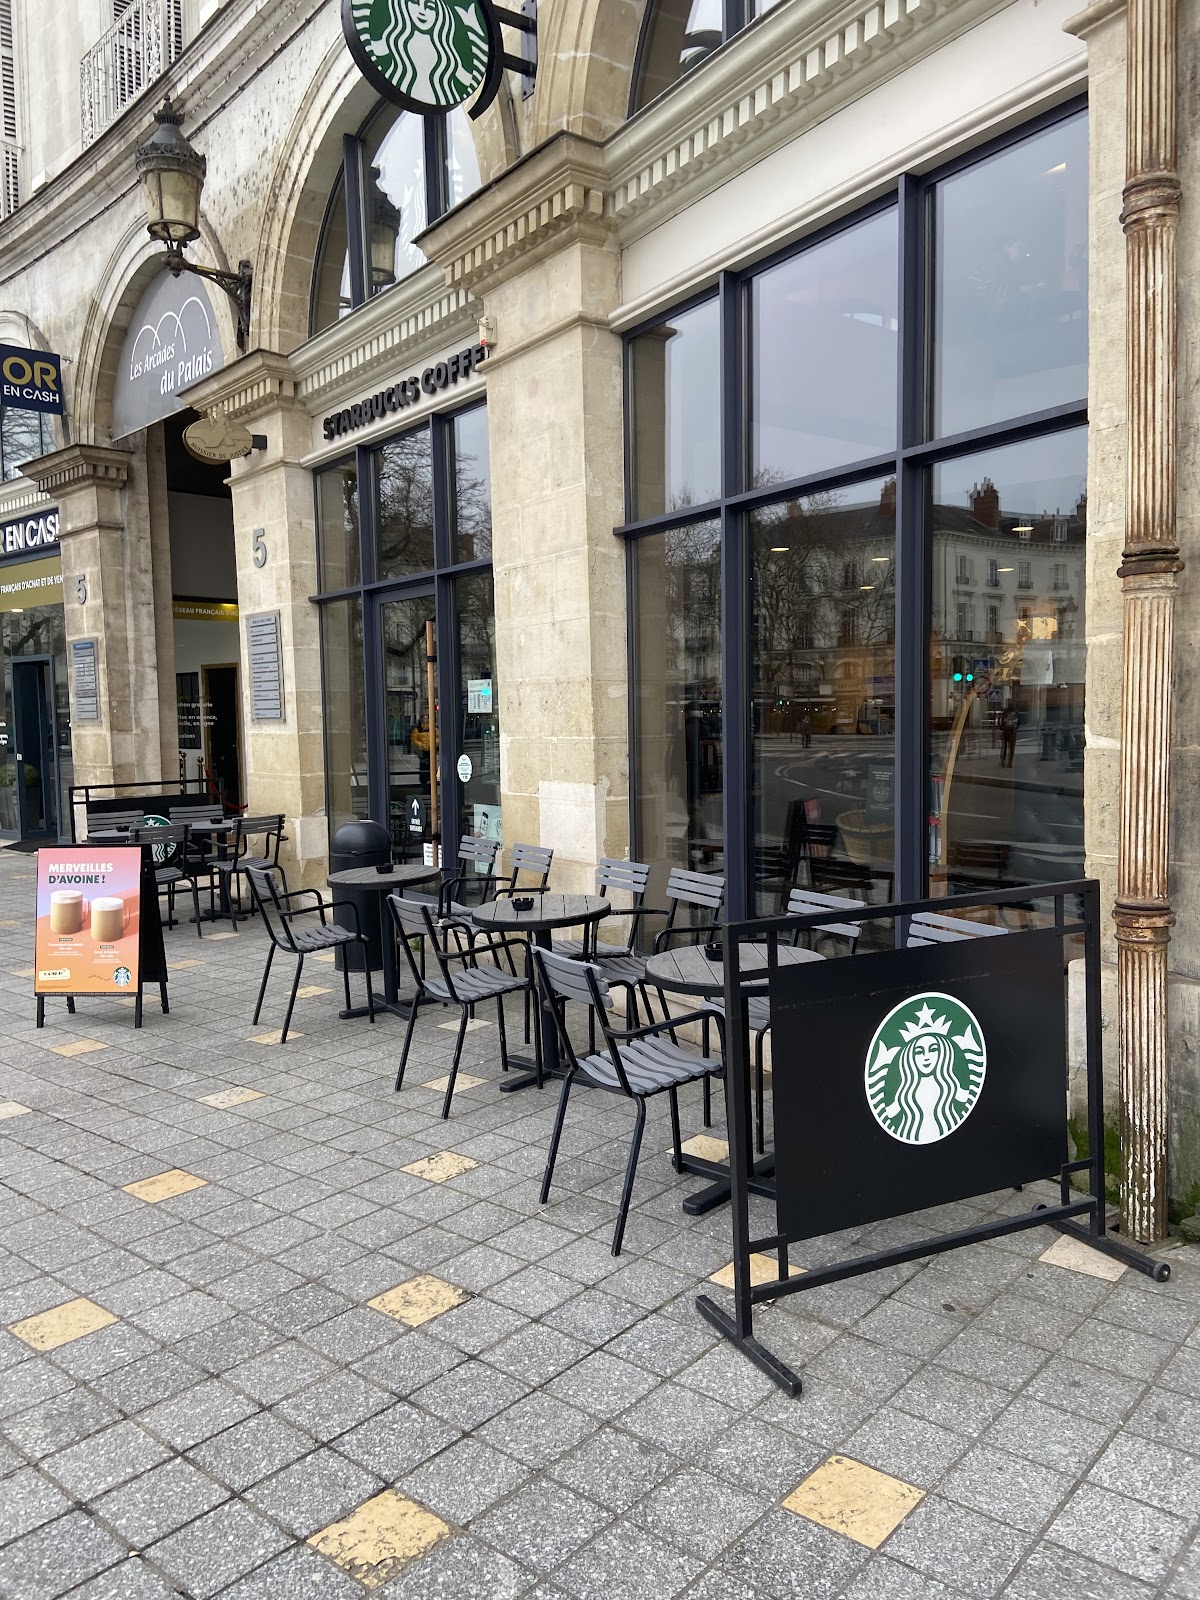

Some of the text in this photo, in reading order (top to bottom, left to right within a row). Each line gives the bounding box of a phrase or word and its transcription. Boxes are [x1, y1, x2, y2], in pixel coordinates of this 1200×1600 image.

[2, 356, 58, 391] OR
[130, 342, 175, 381] Les Arcades
[161, 346, 212, 395] du Palais
[3, 384, 60, 404] EN CASH
[323, 343, 485, 440] STARBUCKS COFFE
[190, 441, 217, 458] HUISSIER
[5, 523, 26, 552] EN
[252, 527, 267, 569] 5
[0, 581, 22, 594] FRANÇAIS
[21, 576, 41, 590] D'ACHAT
[41, 576, 47, 587] ET
[47, 575, 54, 586] DE
[75, 573, 87, 605] 5
[195, 608, 225, 616] FRANÇAIS
[48, 863, 113, 873] MERVEILLES
[48, 875, 99, 884] D'AVOINE
